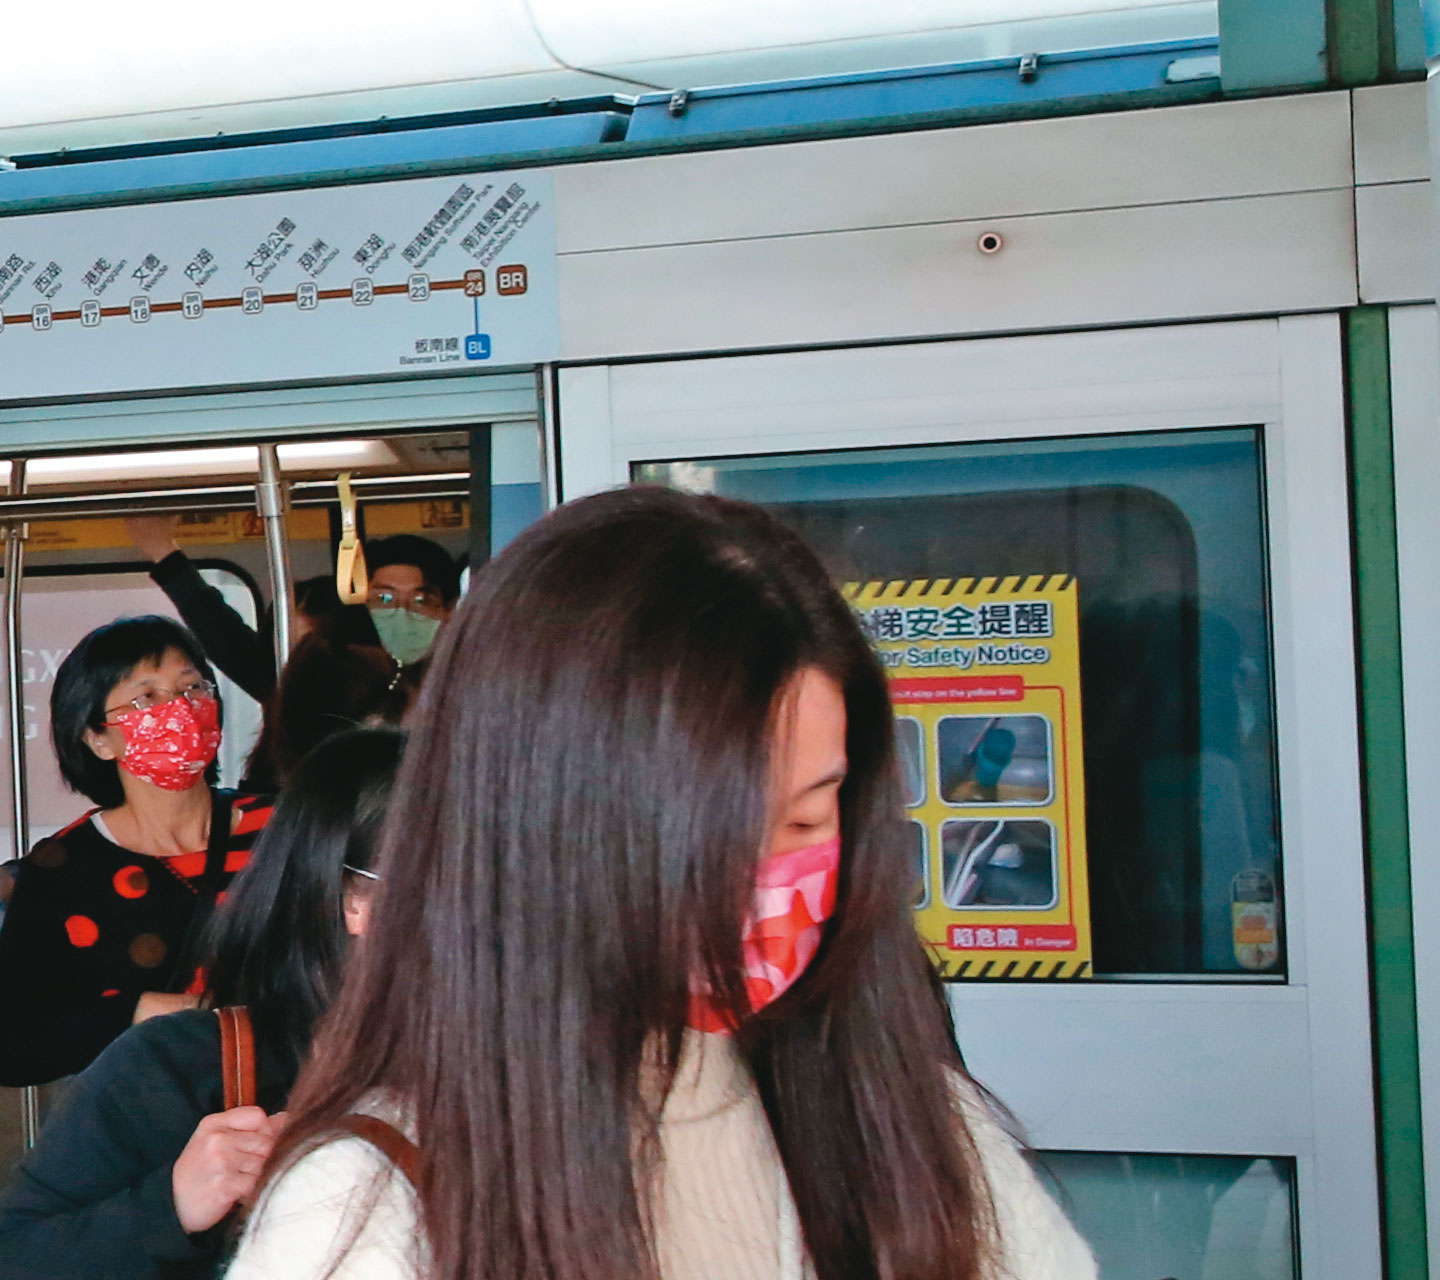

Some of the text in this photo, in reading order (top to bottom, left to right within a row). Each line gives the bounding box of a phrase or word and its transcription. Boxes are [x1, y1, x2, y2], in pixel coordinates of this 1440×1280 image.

[499, 272, 525, 290] BR
[411, 286, 427, 299] 23
[466, 282, 484, 295] 24
[300, 295, 315, 307] 21
[354, 290, 370, 303] 22
[185, 304, 200, 316] 19
[245, 299, 260, 312] 20
[83, 312, 98, 324] 17
[133, 308, 148, 321] 18
[34, 316, 49, 328] 16
[467, 341, 487, 355] BL
[866, 602, 1050, 639] 梯安全提醒
[905, 647, 972, 667] Safety
[978, 645, 1047, 663] Notice
